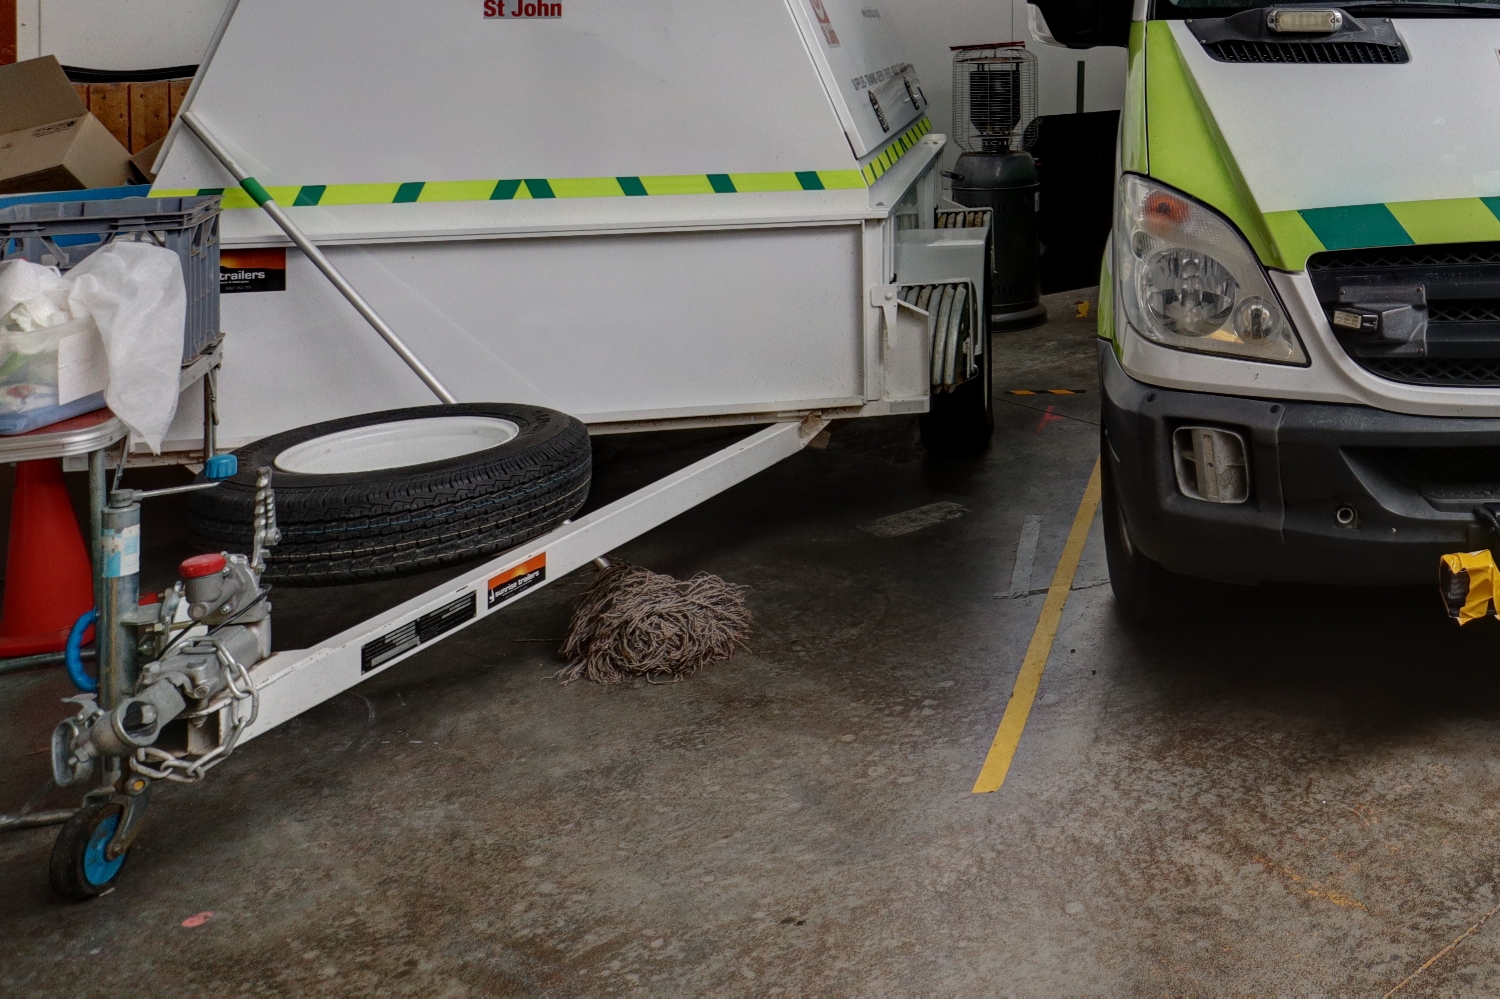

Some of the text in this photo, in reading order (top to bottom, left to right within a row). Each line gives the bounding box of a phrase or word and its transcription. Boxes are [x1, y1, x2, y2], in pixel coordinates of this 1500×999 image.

[483, 0, 505, 17] St
[220, 270, 265, 280] trailers
[495, 582, 518, 598] sunrise
[518, 570, 540, 585] trailers
